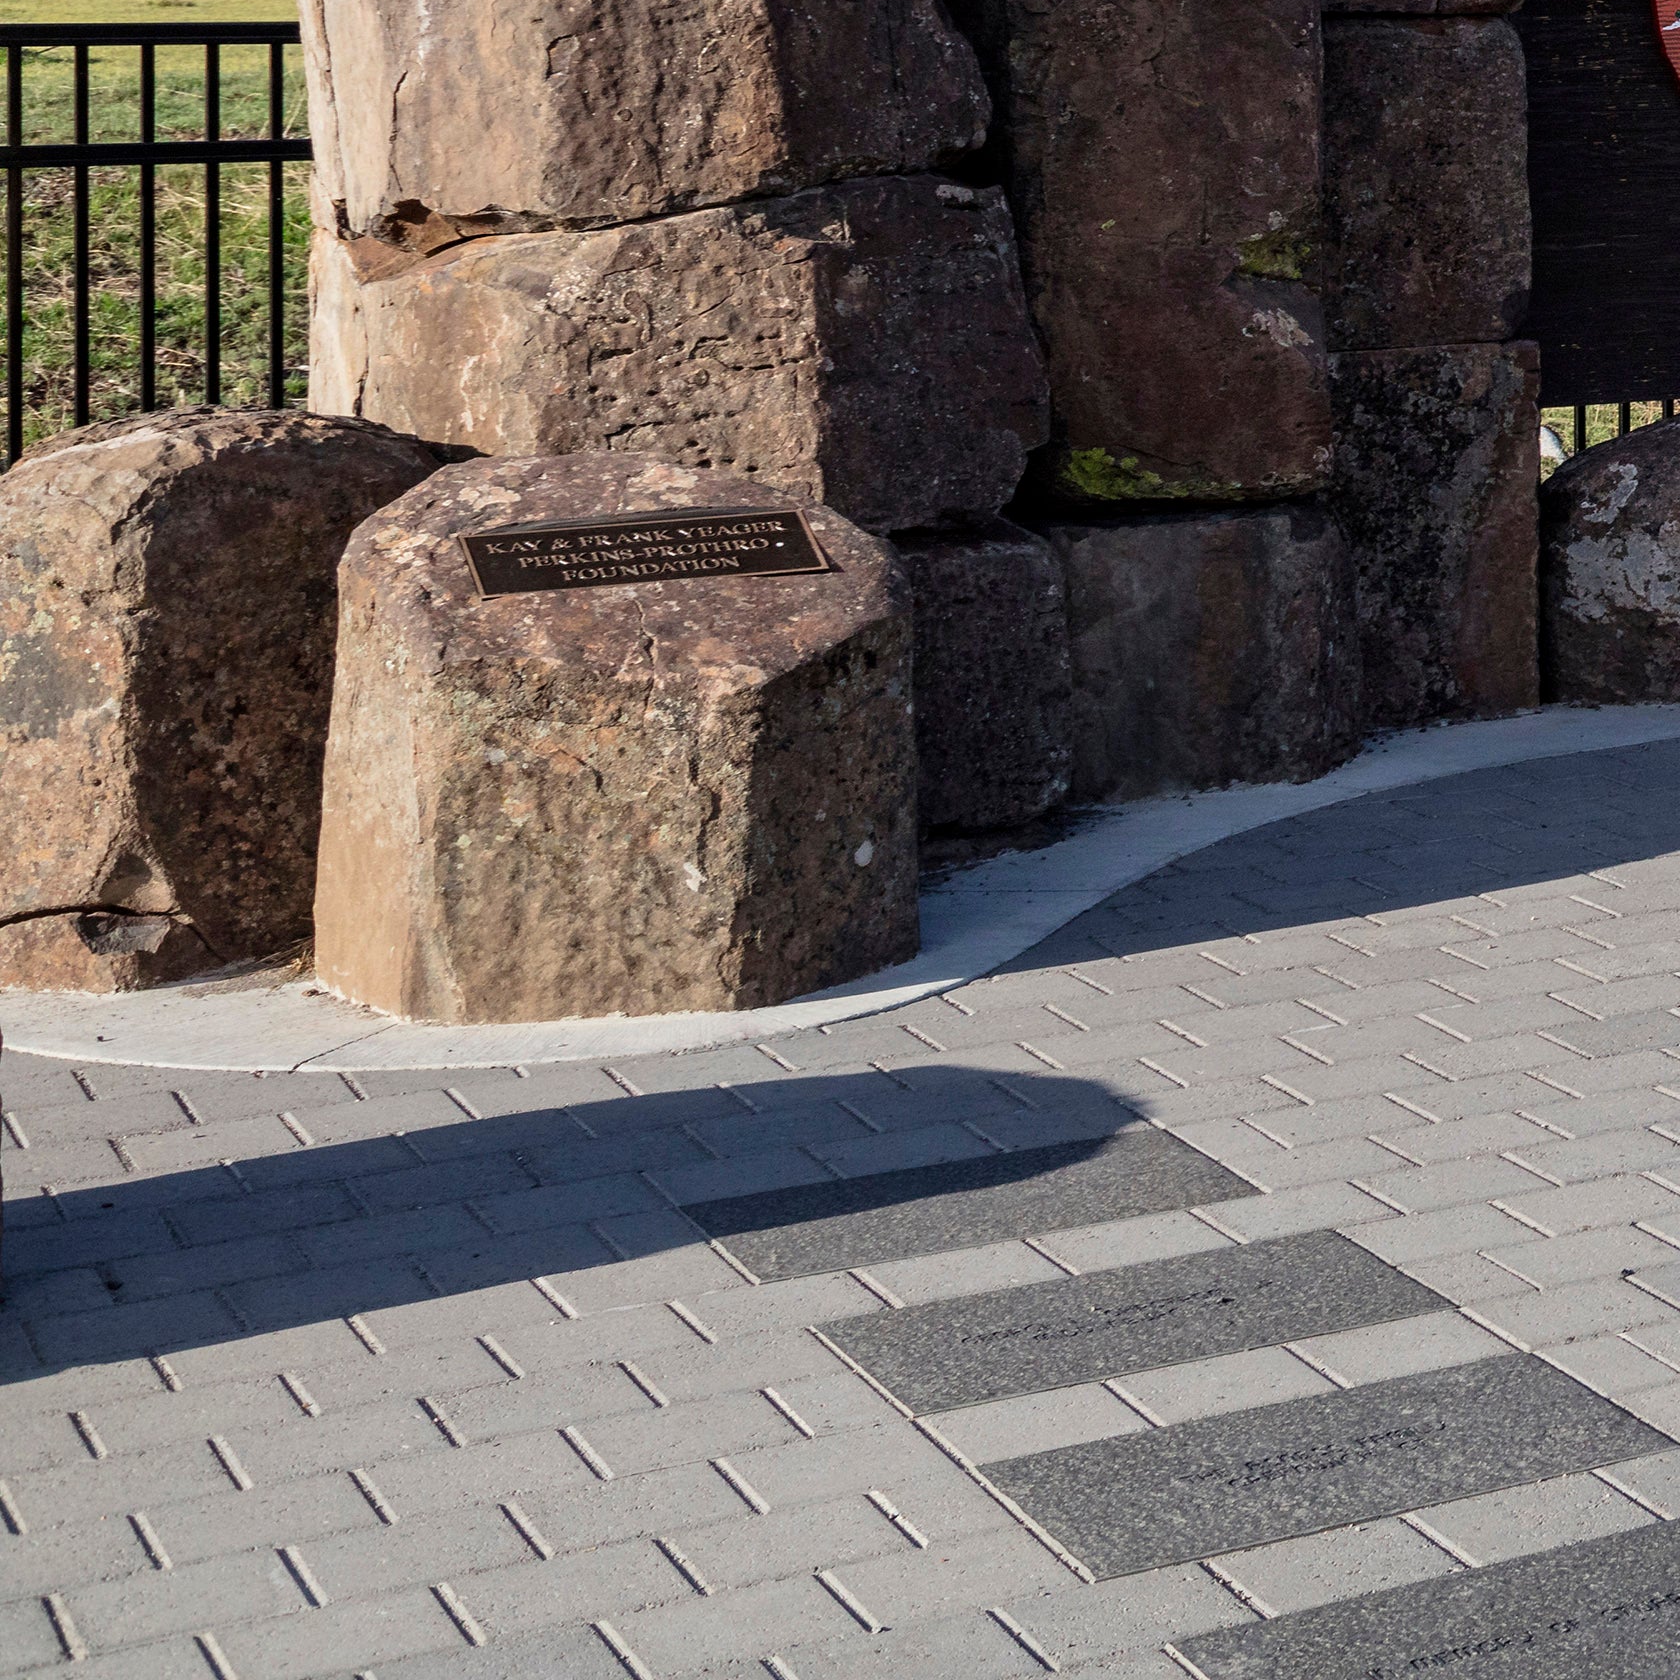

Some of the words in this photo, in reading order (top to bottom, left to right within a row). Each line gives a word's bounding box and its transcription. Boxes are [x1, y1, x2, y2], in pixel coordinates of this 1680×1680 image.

[485, 540, 541, 555] KAY
[551, 538, 574, 550] &
[579, 529, 672, 547] FRANK
[678, 520, 787, 539] YEAGER
[518, 537, 770, 568] PERKINS-PROTHRO
[562, 556, 740, 581] FOUNDATION
